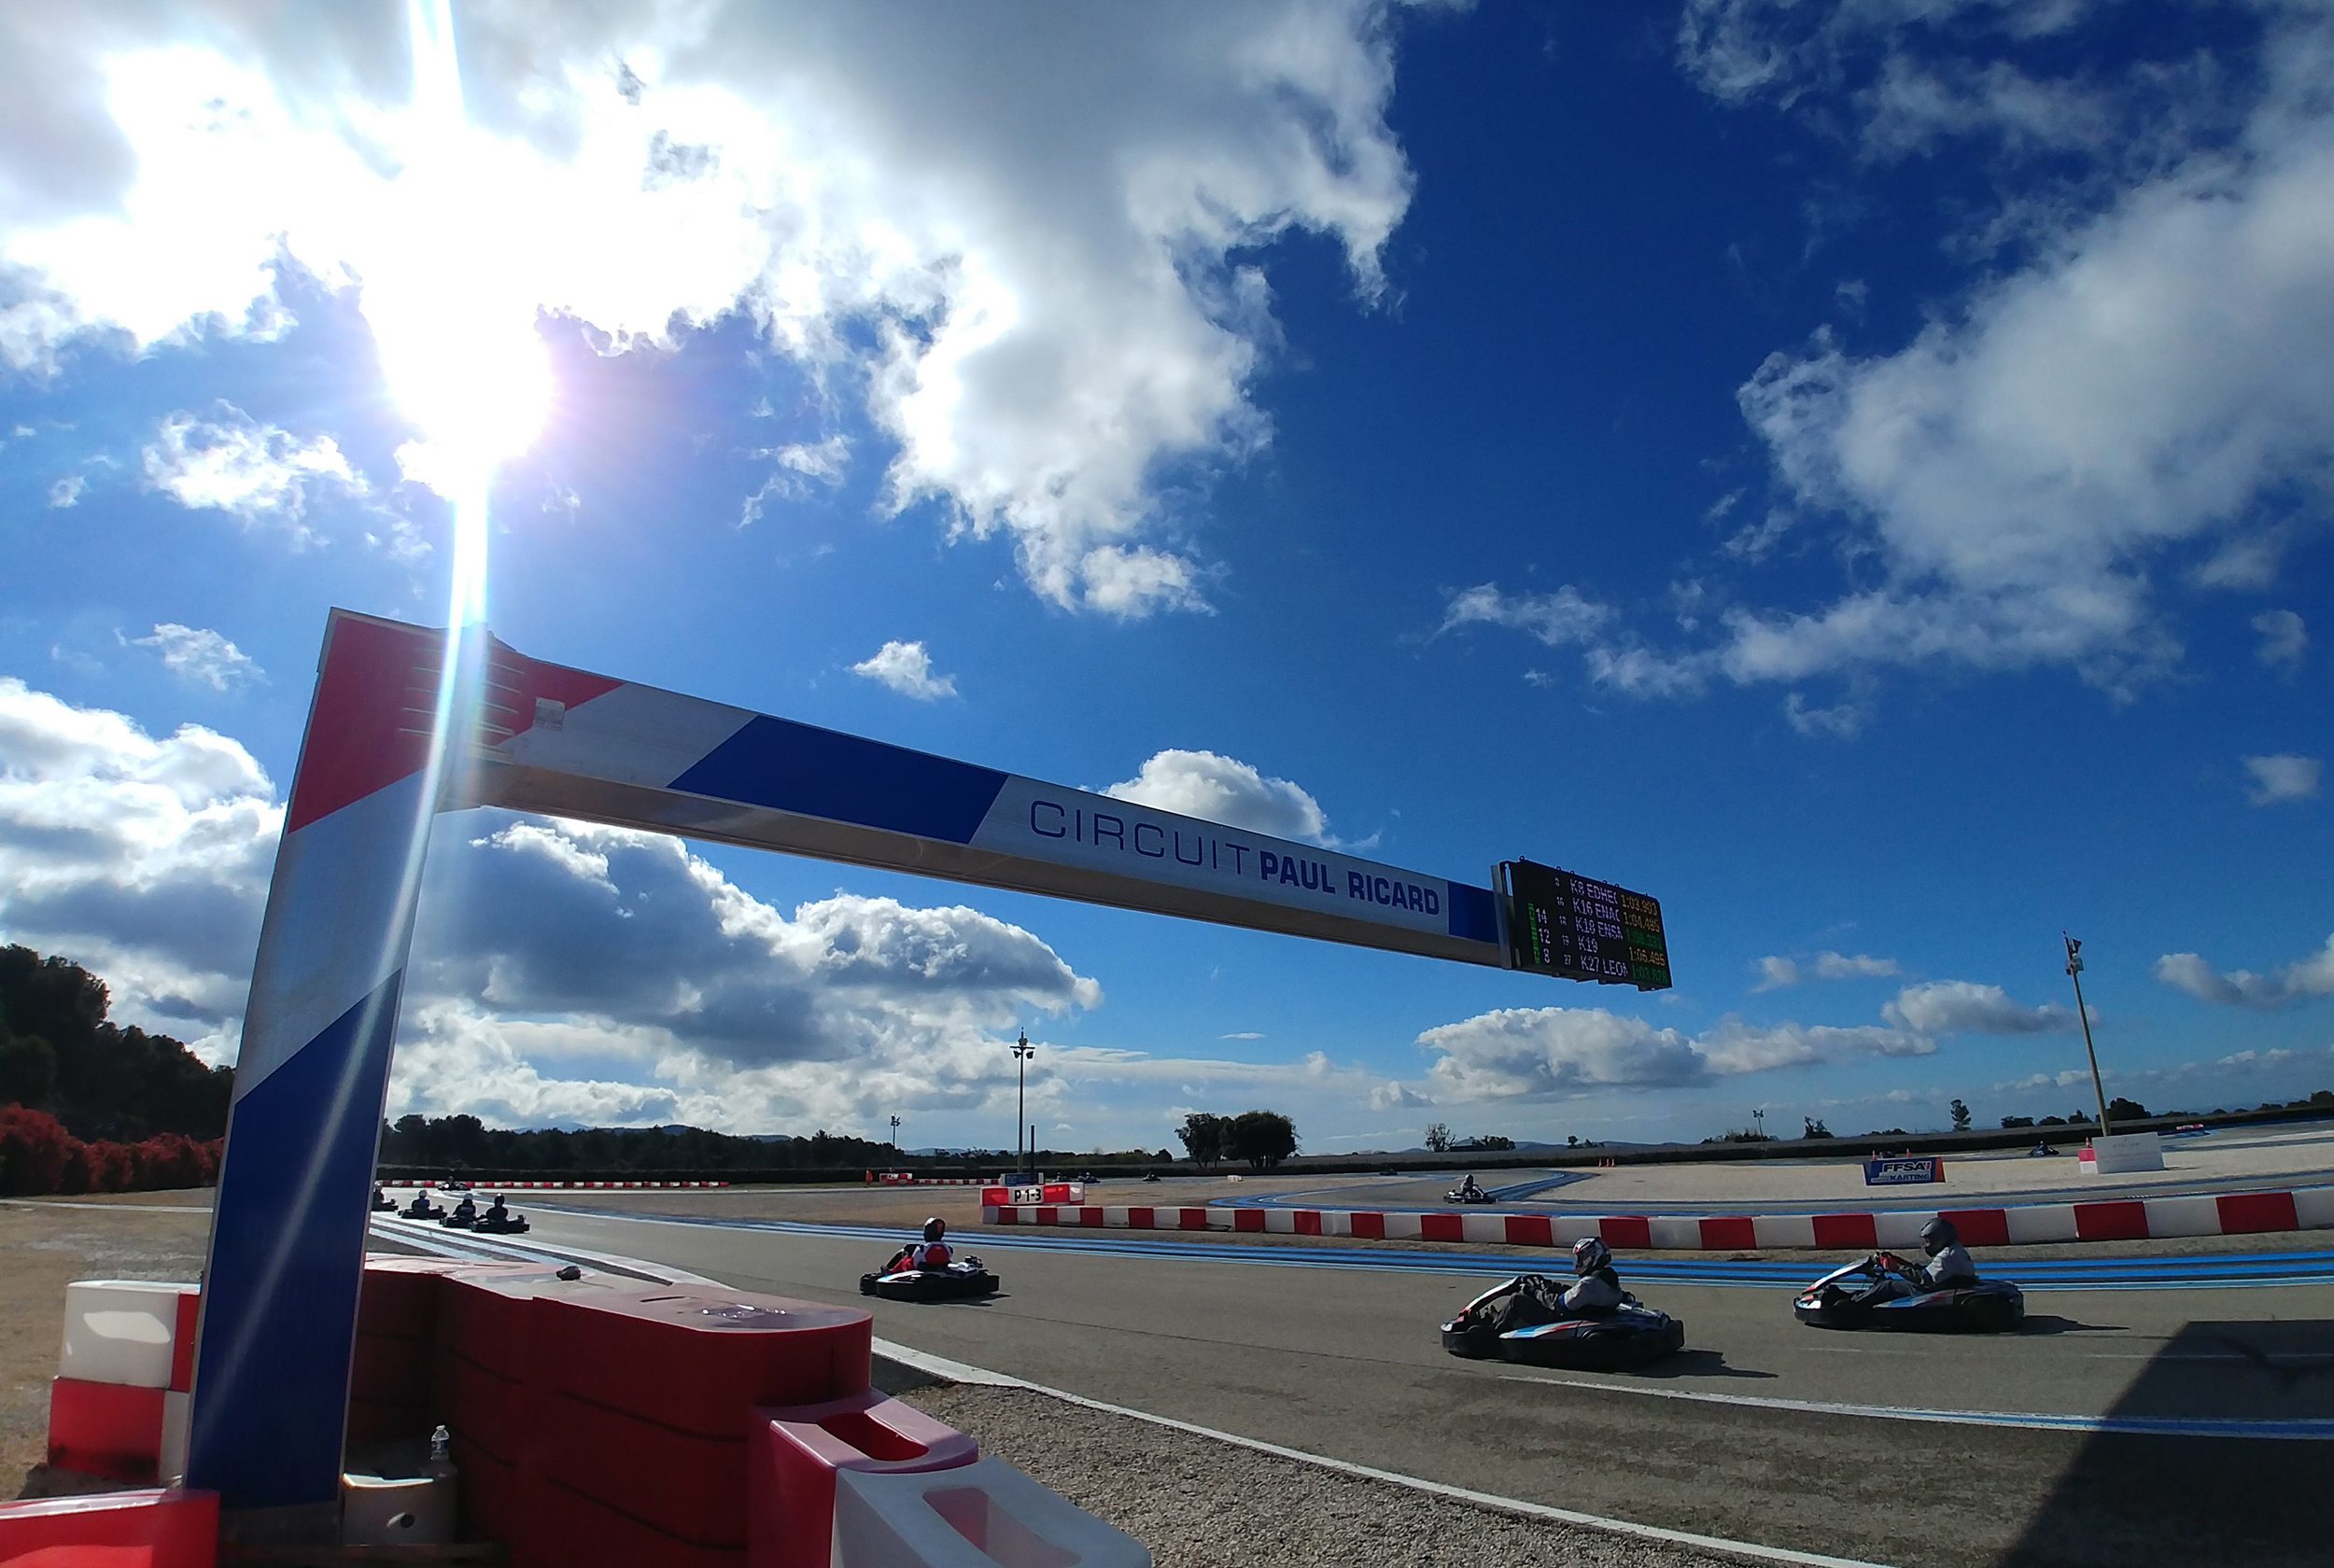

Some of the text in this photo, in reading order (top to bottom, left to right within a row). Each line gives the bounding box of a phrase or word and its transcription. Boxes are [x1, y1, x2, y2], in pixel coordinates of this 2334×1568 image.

[1031, 801, 1440, 915] CIRCUIT PAUL RICARD
[1569, 878, 1585, 895] K8
[1572, 897, 1594, 916] K16
[1536, 907, 1548, 925] 14
[1575, 916, 1596, 934] K18
[1538, 928, 1551, 945] 12
[1578, 935, 1598, 953] K19
[1543, 948, 1551, 963] 8
[1581, 954, 1599, 973] K27
[1883, 1161, 1926, 1172] FFSA
[1014, 1188, 1042, 1202] P 1-3
